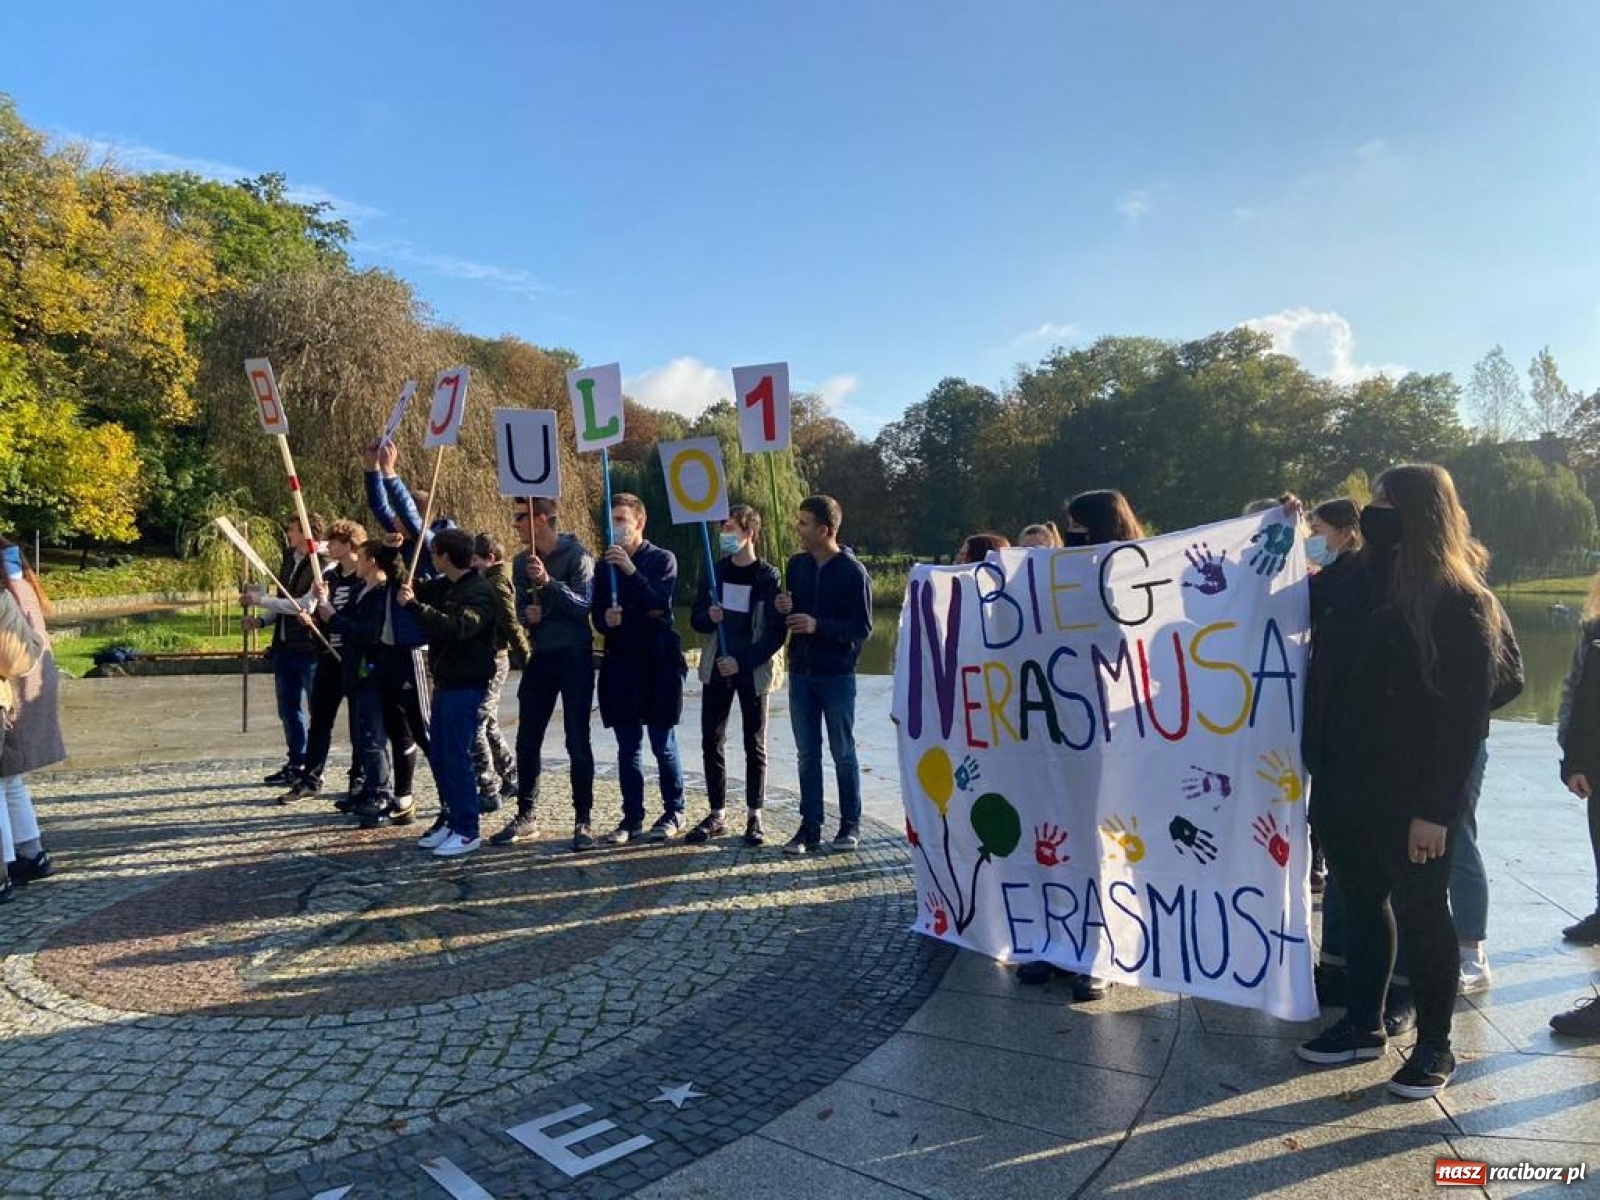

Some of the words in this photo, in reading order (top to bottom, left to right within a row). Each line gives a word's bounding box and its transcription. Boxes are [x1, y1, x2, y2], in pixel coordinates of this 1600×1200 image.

[252, 370, 279, 425] B
[431, 374, 460, 436] J
[576, 378, 619, 441] L
[745, 375, 776, 441] 1
[505, 423, 551, 484] U
[974, 544, 1172, 650] BIEG
[961, 618, 1297, 751] ERASMUSA
[1001, 878, 1304, 988] ERASMUS+
